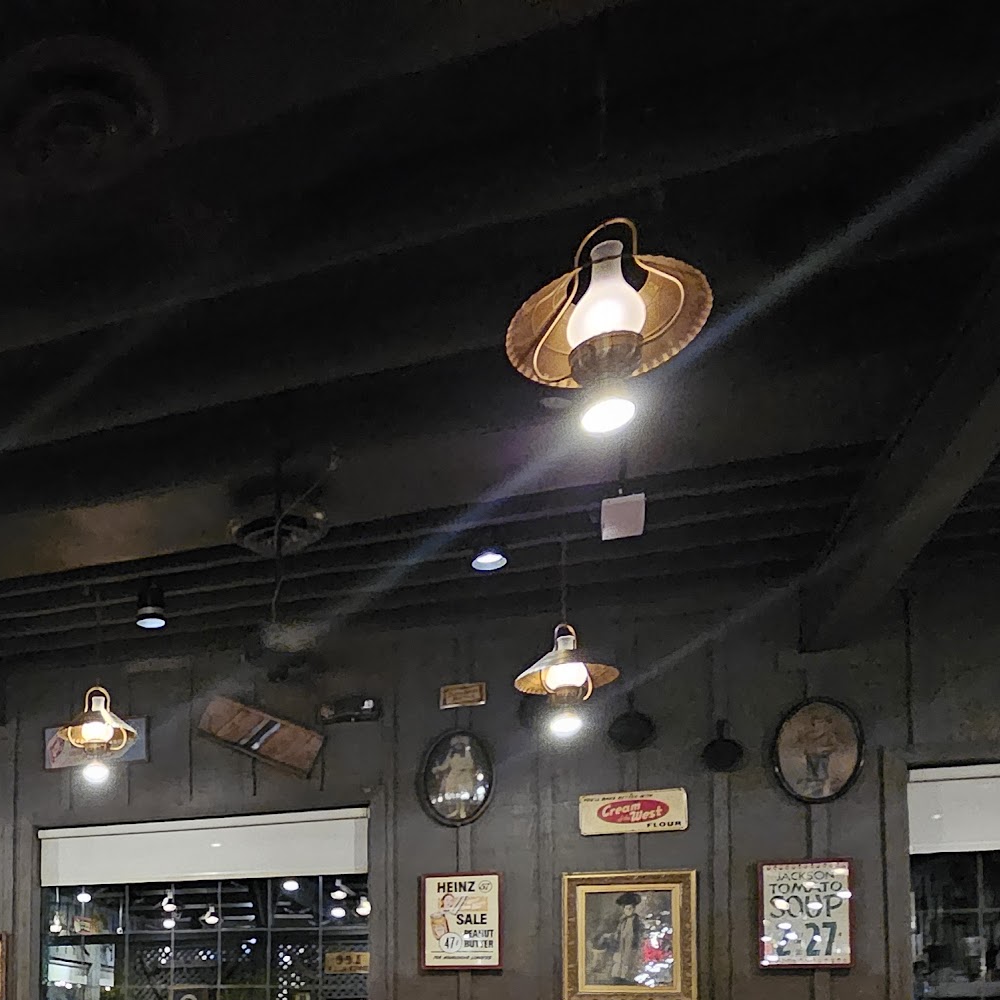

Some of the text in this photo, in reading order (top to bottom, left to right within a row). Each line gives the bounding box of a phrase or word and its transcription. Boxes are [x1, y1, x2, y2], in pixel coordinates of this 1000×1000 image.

[602, 802, 641, 818] Cream
[629, 805, 663, 822] West
[776, 871, 835, 881] JACKSON
[437, 881, 475, 893] HEINZ
[769, 881, 843, 894] TOMATO
[770, 894, 843, 918] SOUP
[456, 913, 487, 925] SALE
[464, 929, 494, 938] PEANUT
